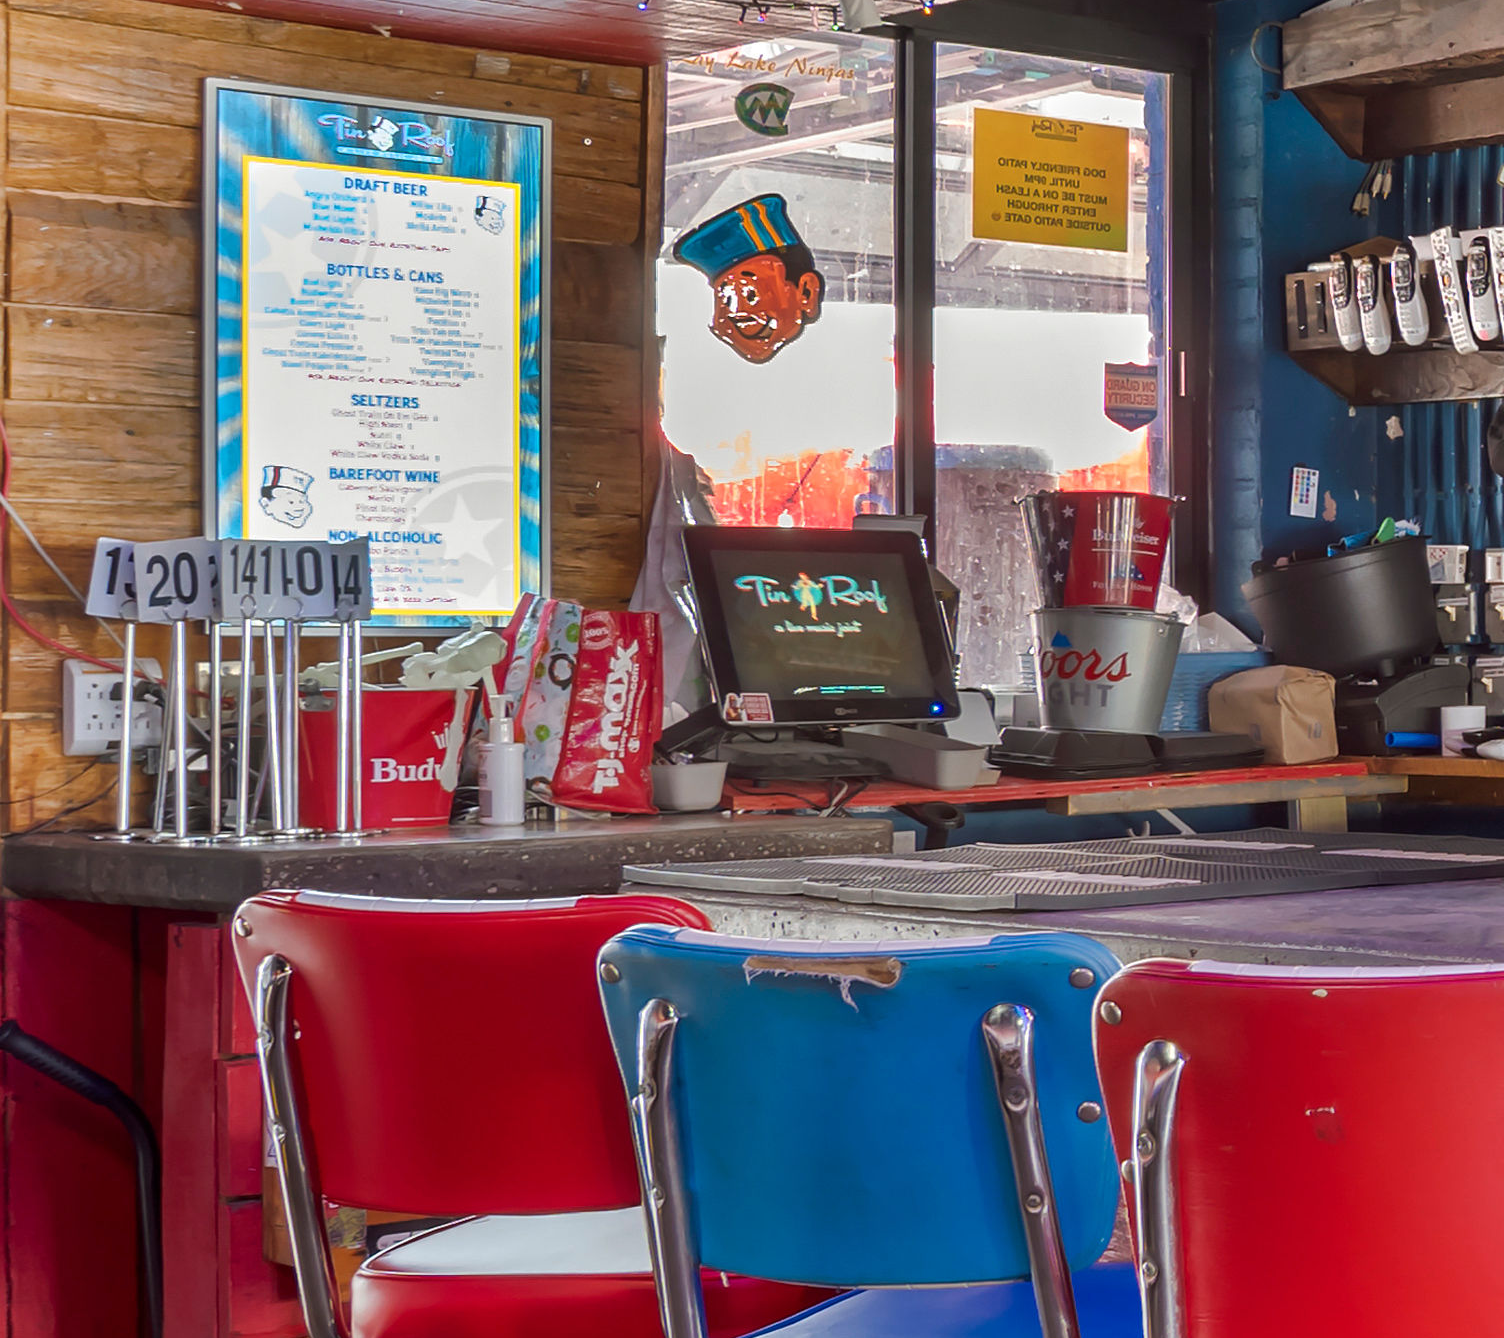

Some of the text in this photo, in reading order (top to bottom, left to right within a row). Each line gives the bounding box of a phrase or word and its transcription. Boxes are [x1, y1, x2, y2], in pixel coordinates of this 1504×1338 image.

[726, 51, 855, 81] Lake Ninjas
[317, 114, 455, 158] Tin Roof
[344, 177, 428, 196] DRAFT BEER
[326, 263, 444, 284] BOTTLES & CANS
[351, 394, 420, 409] SELTZERS
[329, 467, 441, 484] BAREFOOT WINE
[147, 552, 198, 607] 20
[735, 575, 888, 613] Tin Roof
[1037, 647, 1131, 682] oors
